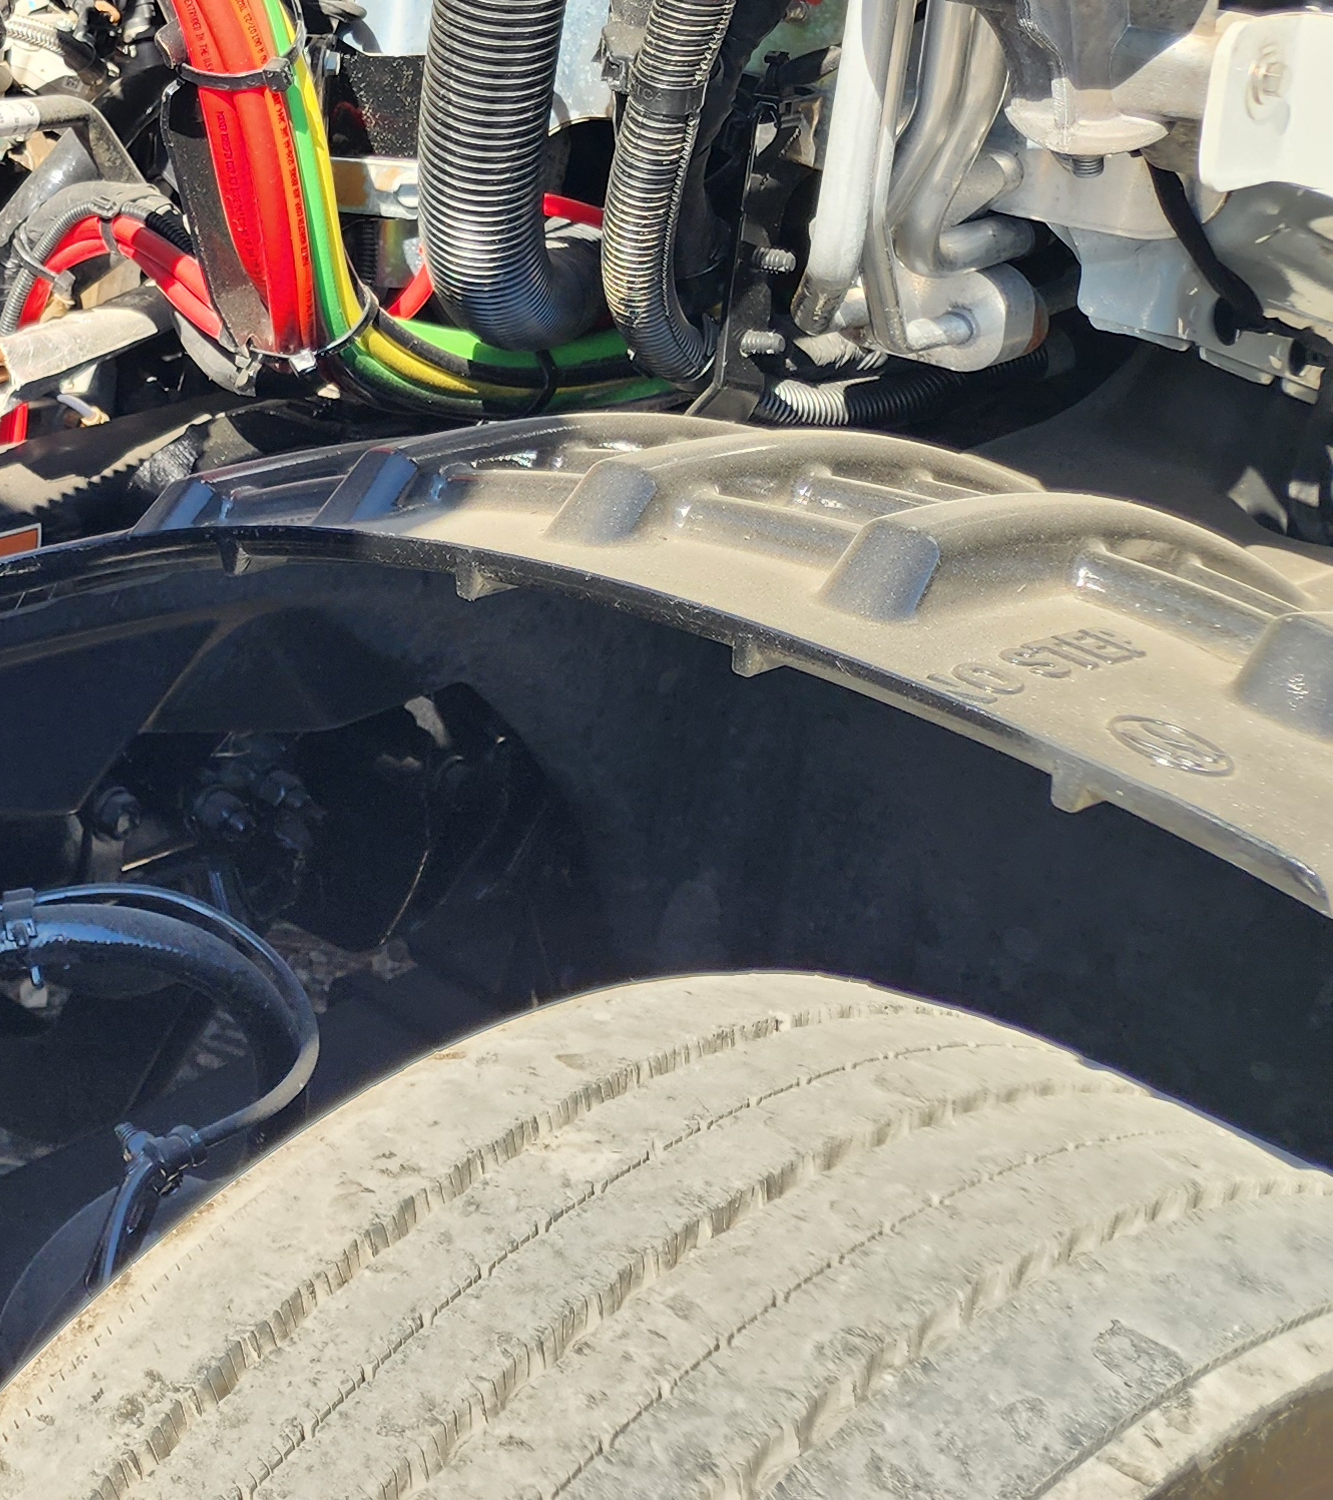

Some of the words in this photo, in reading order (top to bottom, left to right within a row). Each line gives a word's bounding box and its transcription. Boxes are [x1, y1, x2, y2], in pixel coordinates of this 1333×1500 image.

[198, 40, 208, 56] THE
[926, 661, 1025, 706] NO
[997, 625, 1147, 680] STEP
